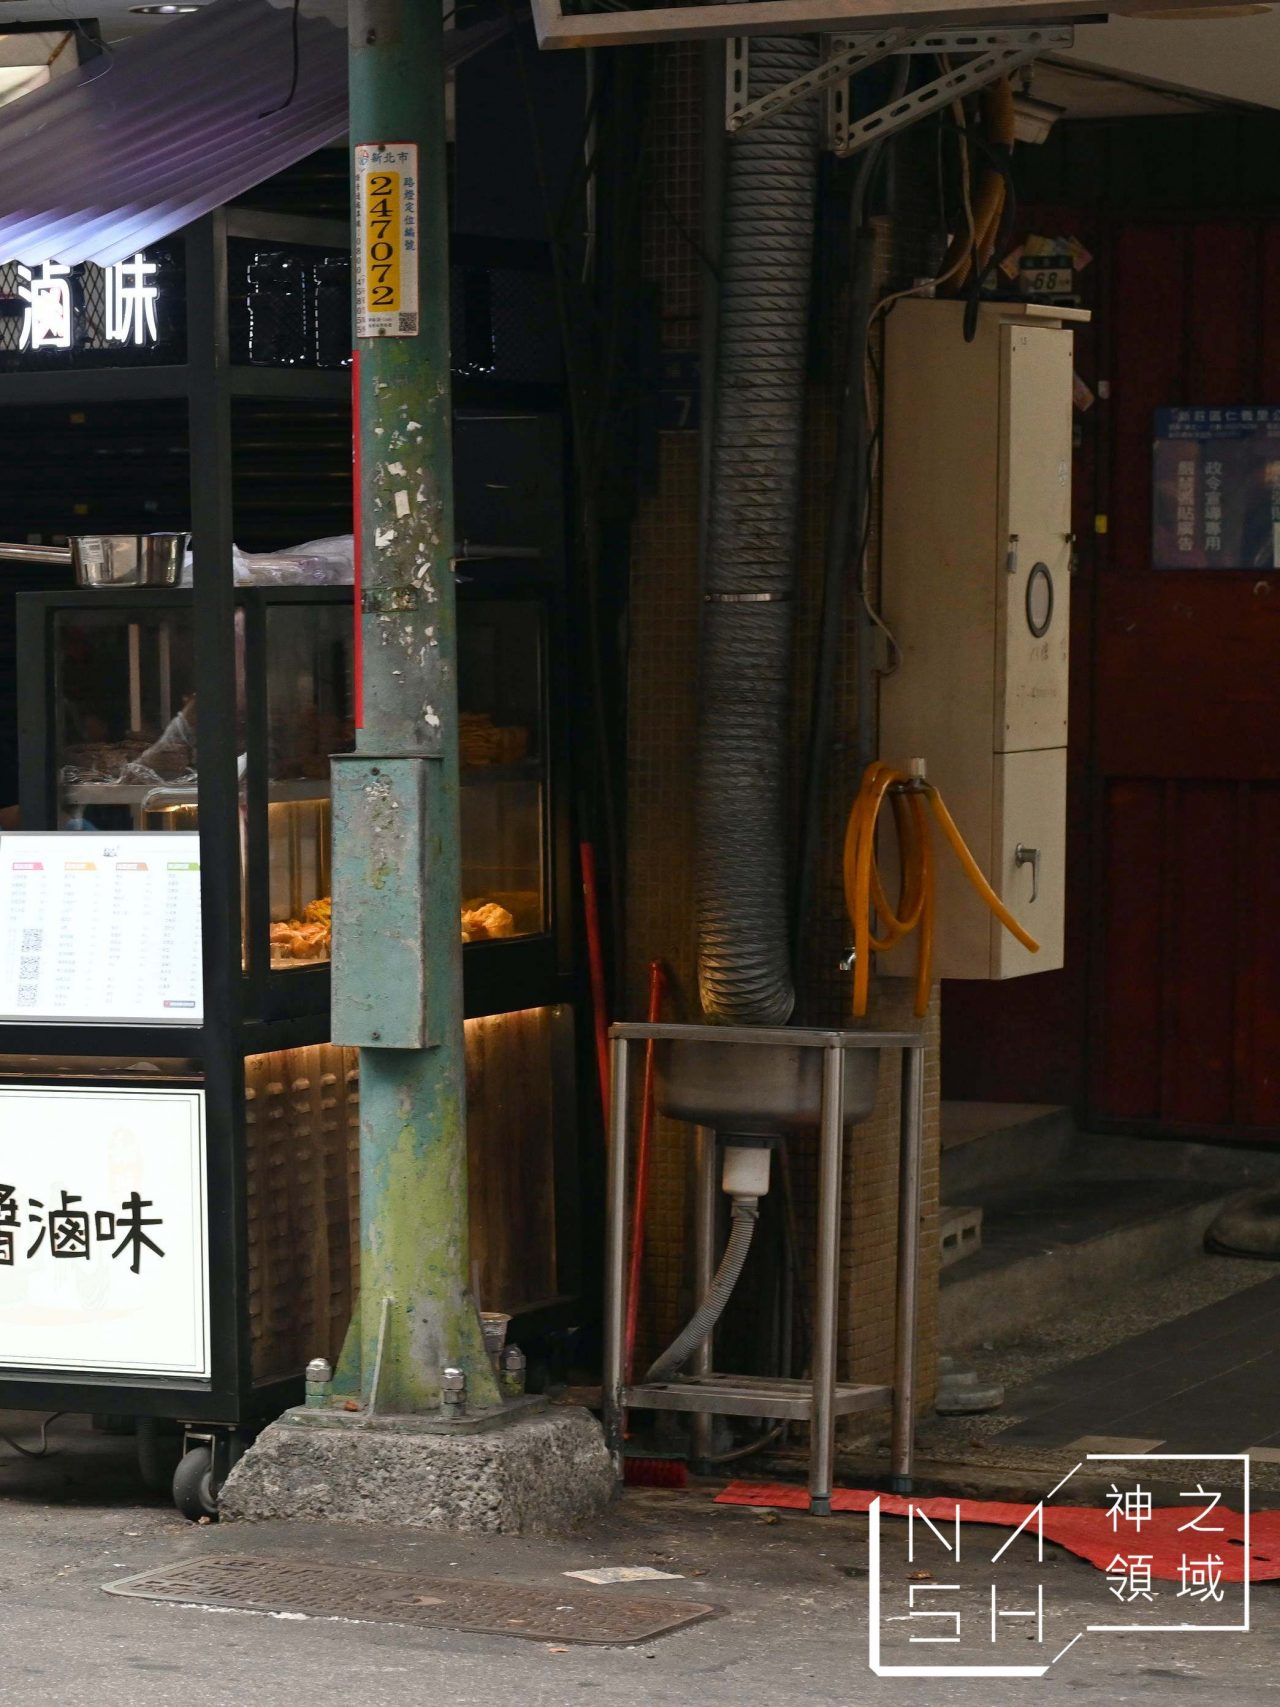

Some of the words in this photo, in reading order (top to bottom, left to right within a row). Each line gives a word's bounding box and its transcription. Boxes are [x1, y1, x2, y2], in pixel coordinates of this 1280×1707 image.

[370, 151, 409, 164] 新北市
[403, 176, 416, 251] 路燈定位編號
[369, 176, 395, 306] 247072
[1033, 270, 1059, 291] 68
